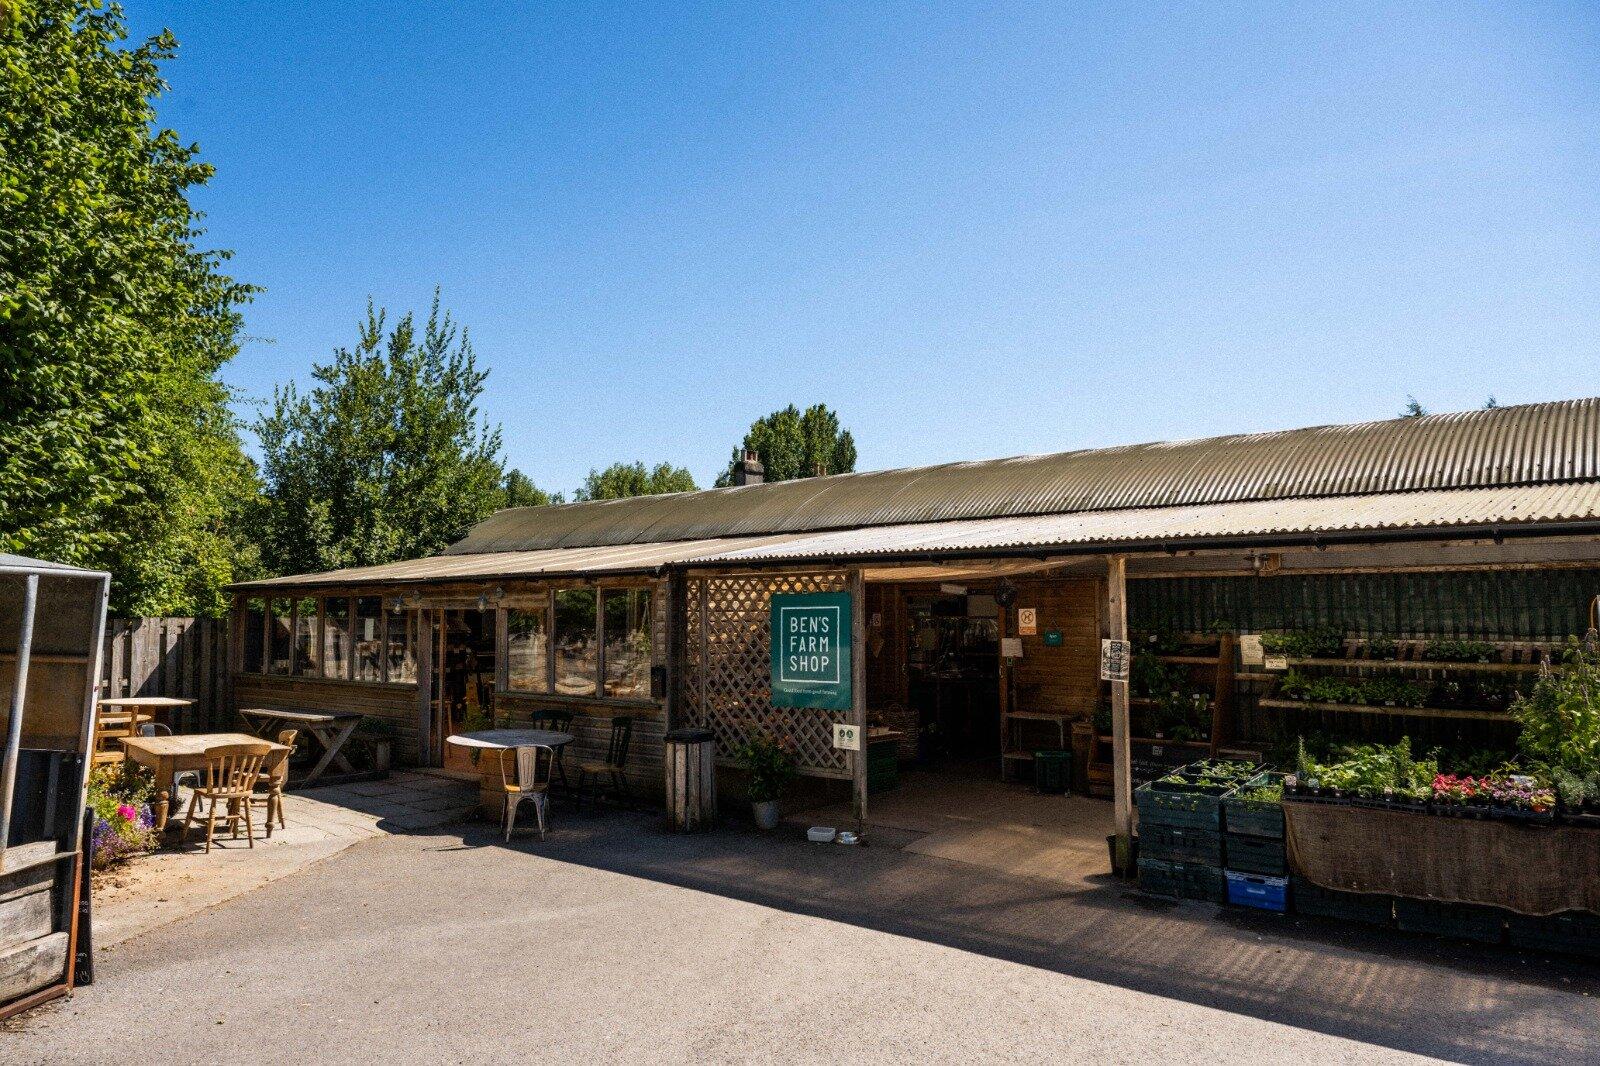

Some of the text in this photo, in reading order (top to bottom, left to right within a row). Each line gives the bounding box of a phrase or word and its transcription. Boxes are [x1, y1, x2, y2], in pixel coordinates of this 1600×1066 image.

[790, 616, 830, 633] BEN'S
[790, 636, 829, 652] FARM
[790, 655, 830, 672] SHOP
